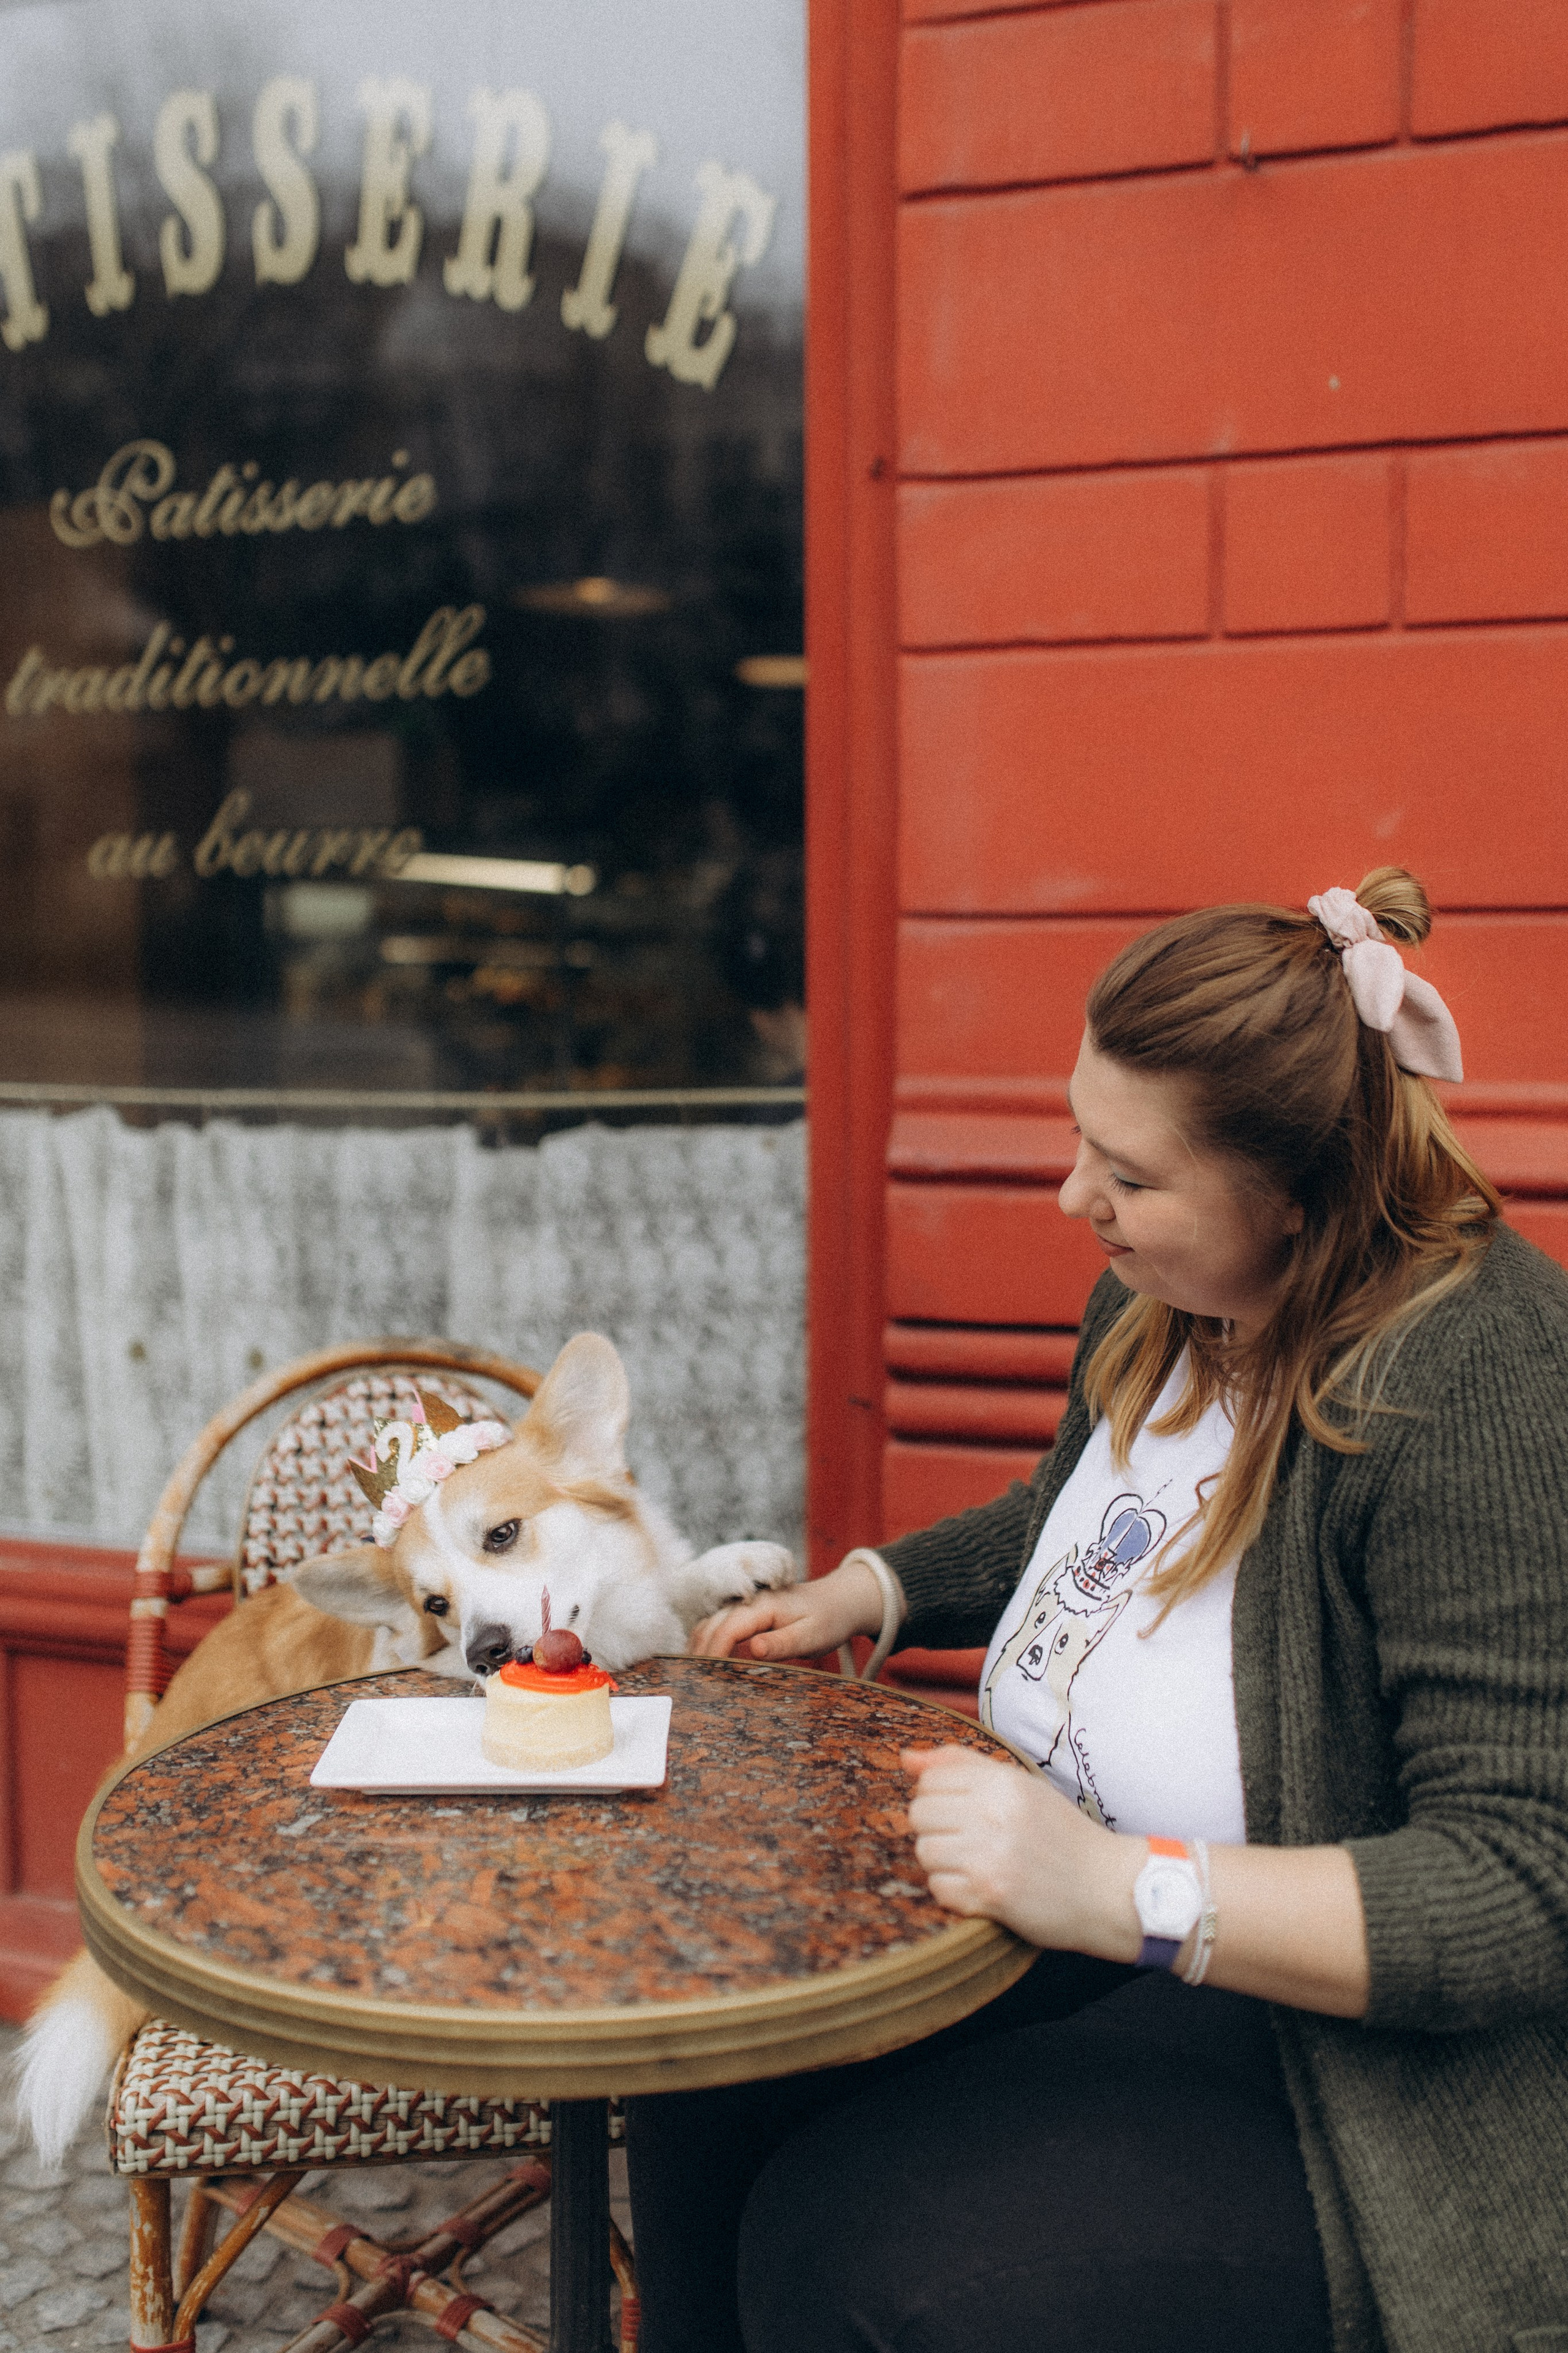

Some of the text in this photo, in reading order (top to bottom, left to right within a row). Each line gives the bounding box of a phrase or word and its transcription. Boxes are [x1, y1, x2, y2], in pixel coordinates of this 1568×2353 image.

[50, 439, 437, 549] Patisserie
[5, 604, 491, 717] traditionnelle
[88, 786, 423, 880] au beurre
